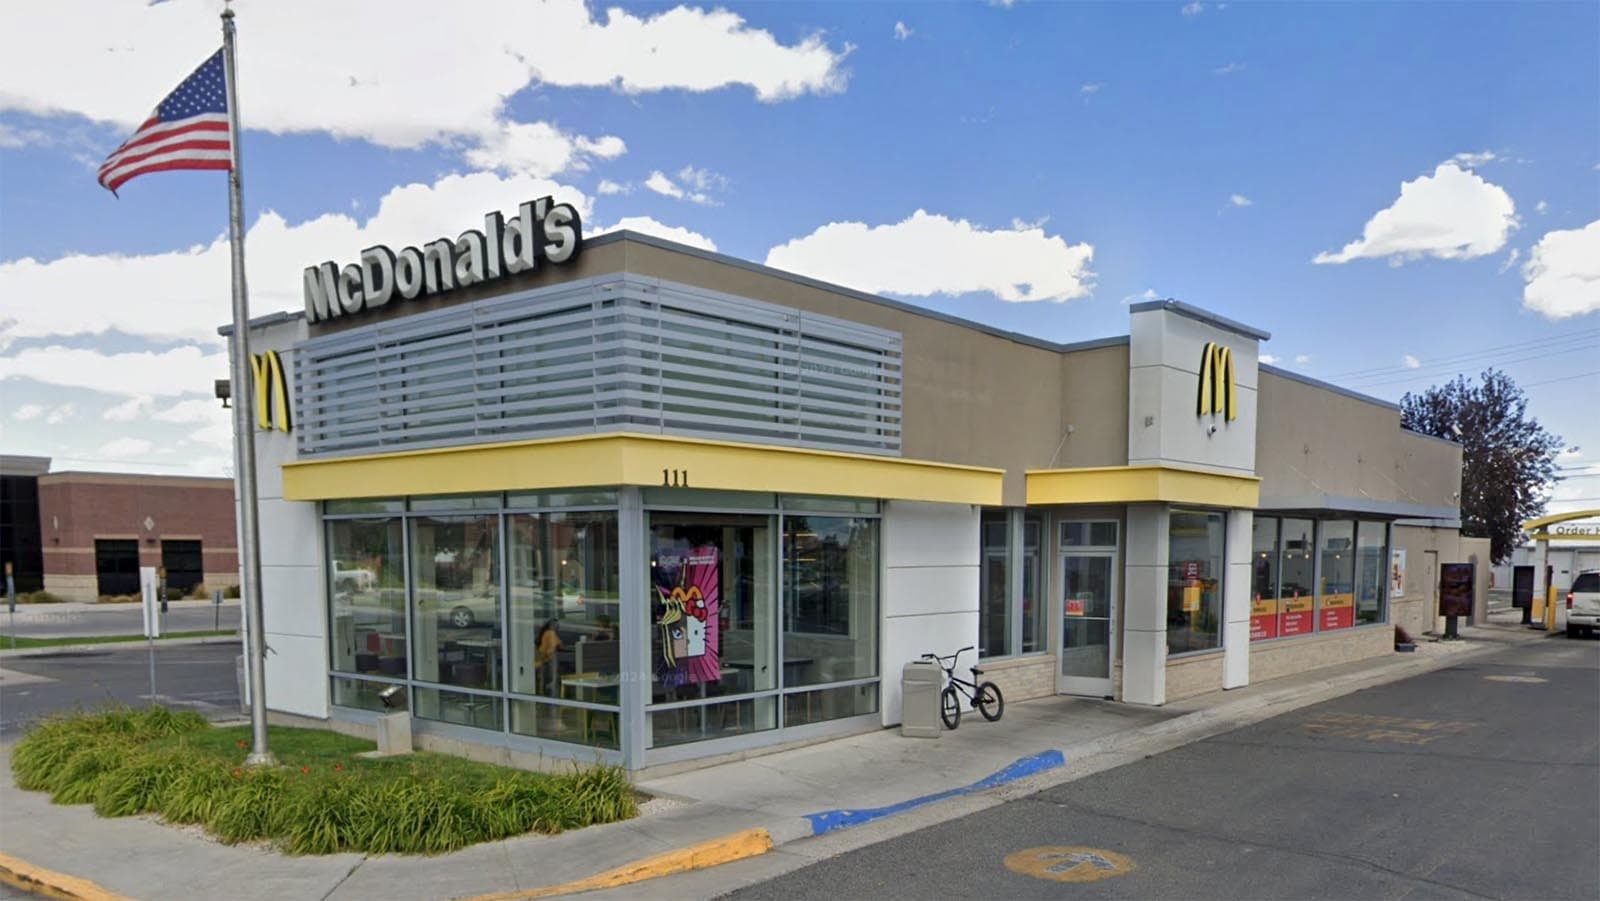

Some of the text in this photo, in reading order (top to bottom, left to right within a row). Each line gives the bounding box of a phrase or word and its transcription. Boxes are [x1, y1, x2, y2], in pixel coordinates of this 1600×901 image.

[303, 195, 583, 325] McDonald's
[662, 468, 689, 487] 111
[1556, 526, 1591, 535] Order
